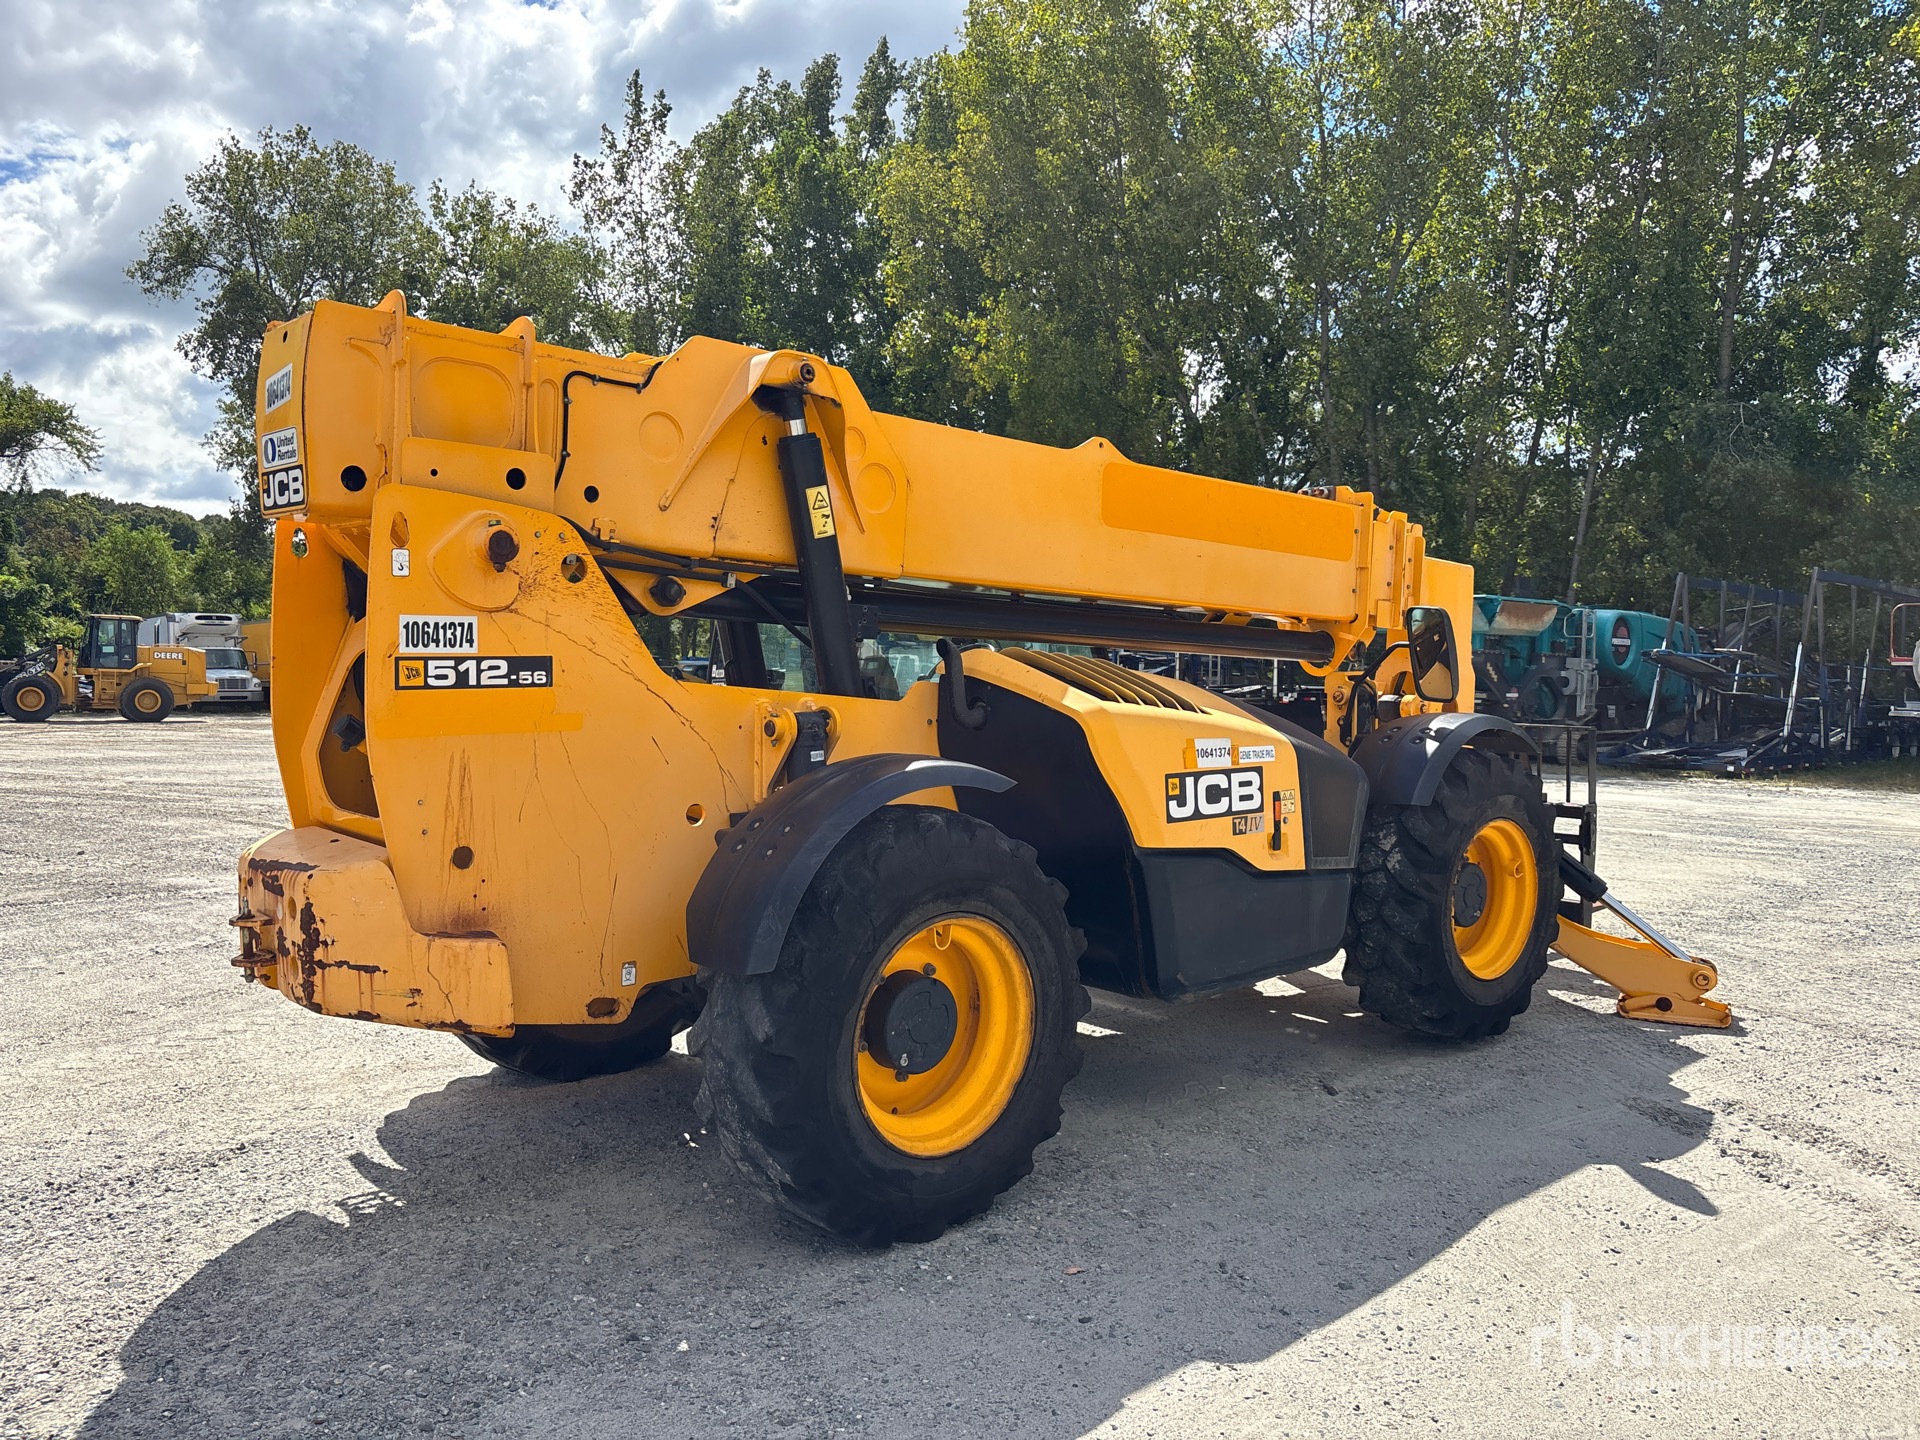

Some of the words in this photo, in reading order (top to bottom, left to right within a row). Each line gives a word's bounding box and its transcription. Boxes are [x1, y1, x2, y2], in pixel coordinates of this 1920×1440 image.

[266, 369, 291, 410] 10641374
[276, 432, 295, 448] United
[277, 447, 297, 462] Rentals
[263, 468, 304, 507] JCB
[402, 620, 475, 648] 10641374
[153, 651, 184, 660] DEERE
[426, 659, 547, 687] 512-56
[1196, 747, 1231, 759] 10641374
[1252, 749, 1265, 759] TRADE
[1168, 771, 1262, 819] JCB
[1233, 817, 1246, 834] T4
[1248, 816, 1263, 832] IV
